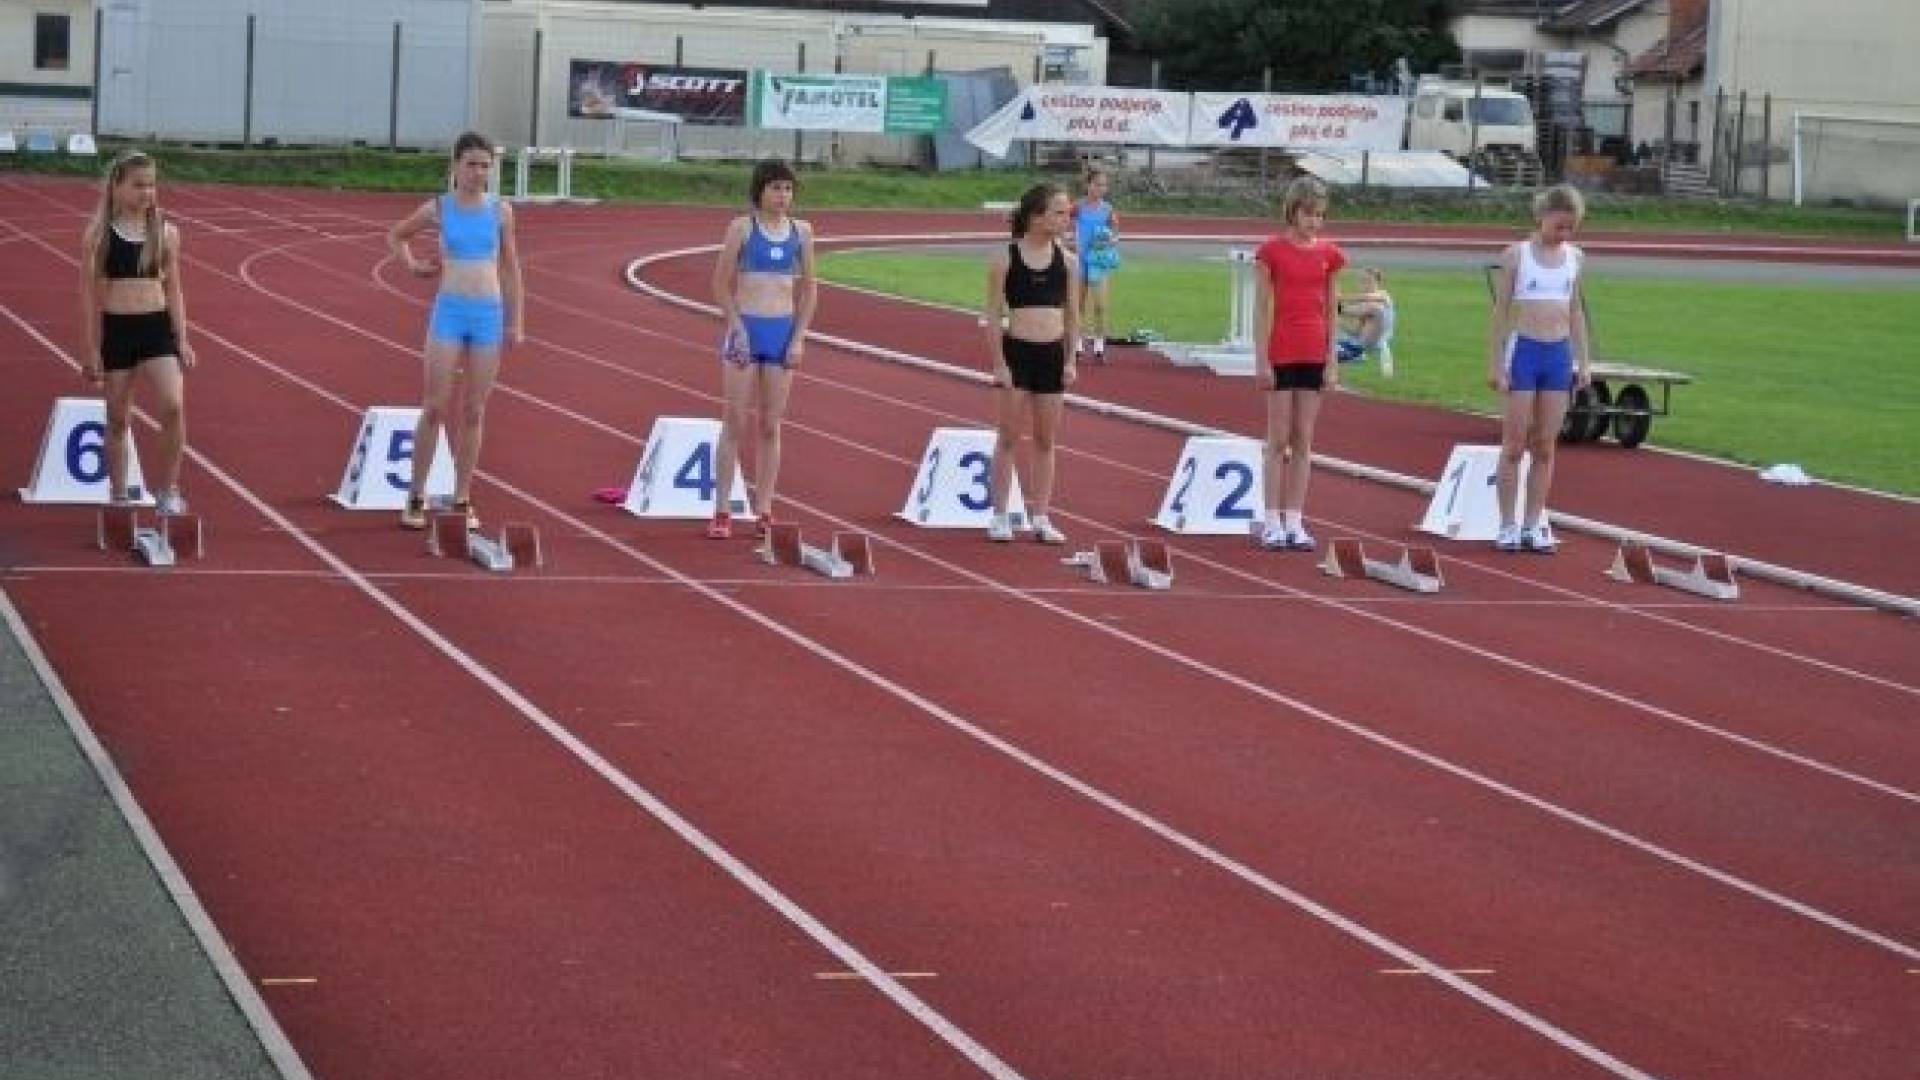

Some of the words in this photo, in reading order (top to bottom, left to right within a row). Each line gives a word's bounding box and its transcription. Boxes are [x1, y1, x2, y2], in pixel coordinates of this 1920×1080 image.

[647, 73, 744, 92] SCOTT
[66, 421, 108, 484] 6
[386, 430, 414, 488] 5
[673, 442, 717, 501] 4
[959, 452, 996, 510] 3
[1215, 460, 1255, 519] 2
